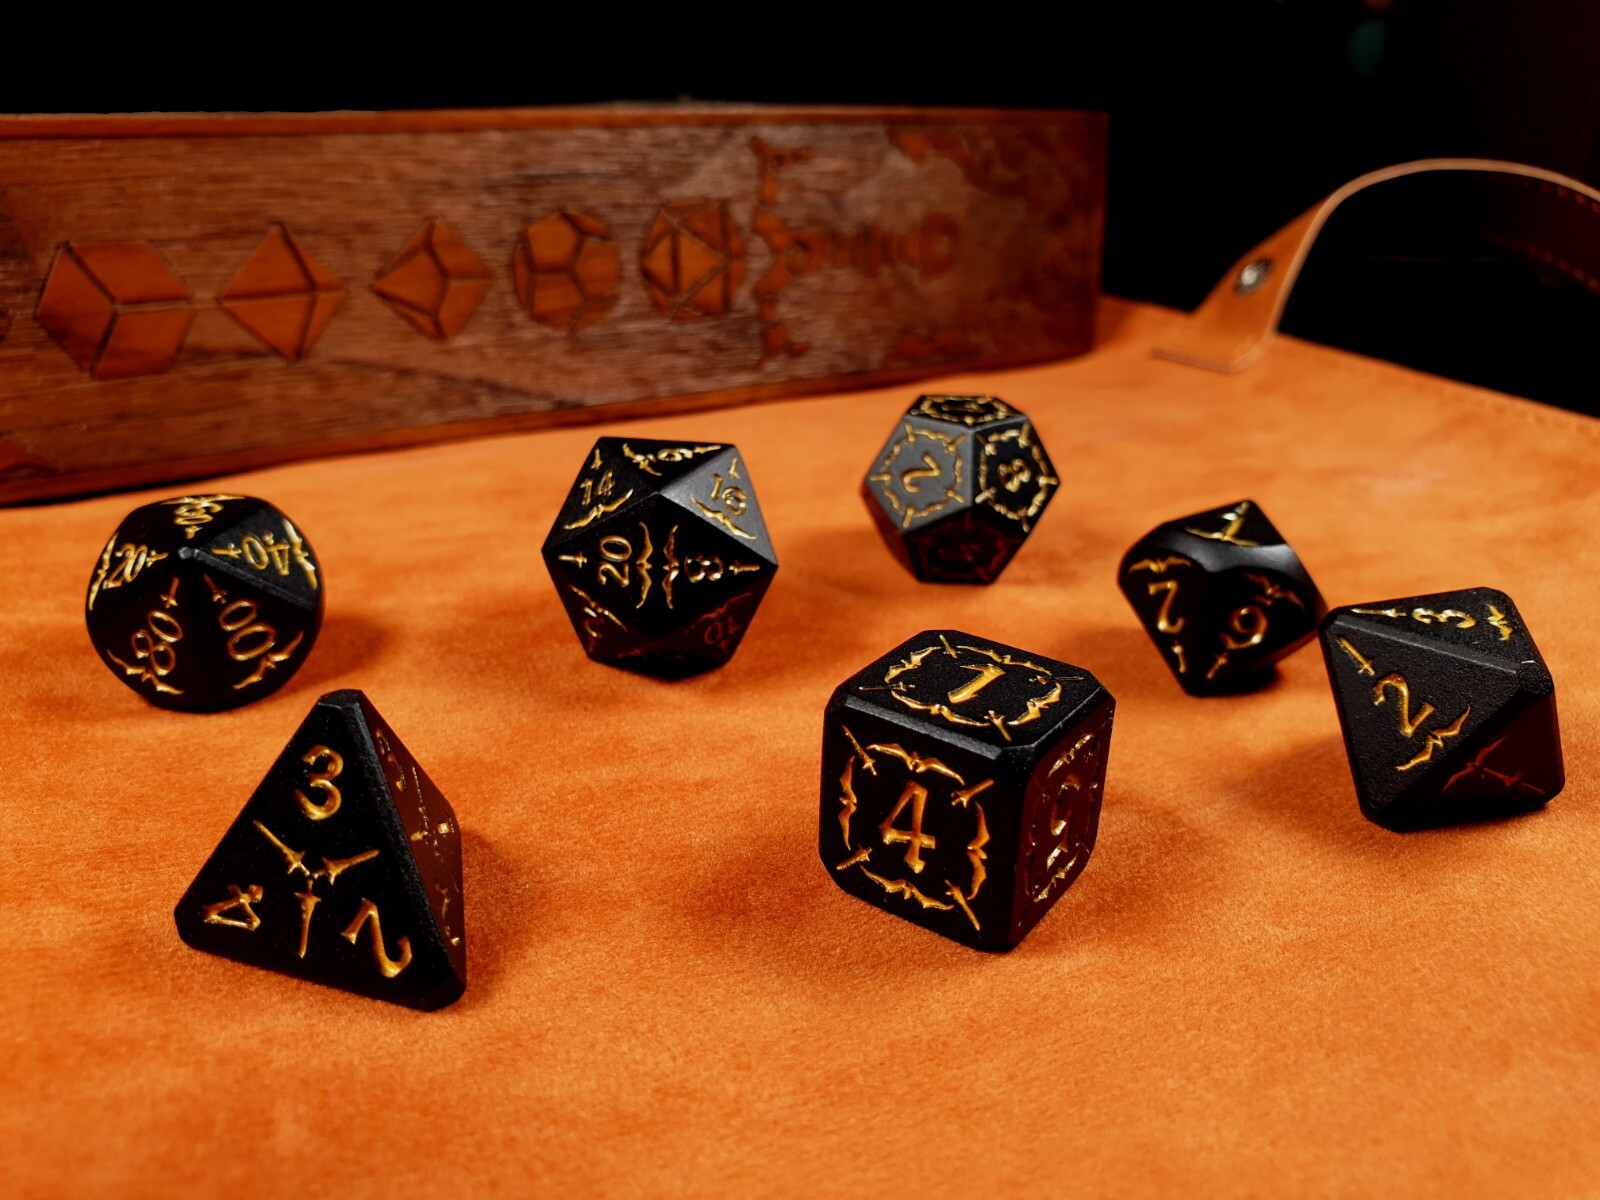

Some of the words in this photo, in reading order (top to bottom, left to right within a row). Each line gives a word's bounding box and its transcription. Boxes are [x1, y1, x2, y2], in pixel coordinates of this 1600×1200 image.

[710, 473, 747, 516] 16
[102, 543, 148, 589] 20
[599, 535, 632, 588] 20
[684, 553, 724, 584] 8
[131, 610, 184, 676] 80
[219, 600, 277, 662] 00
[1412, 607, 1477, 629] 3
[959, 663, 1007, 704] 1
[1373, 672, 1436, 738] 2
[293, 744, 344, 820] 3
[878, 780, 936, 874] 4
[201, 884, 264, 932] 4
